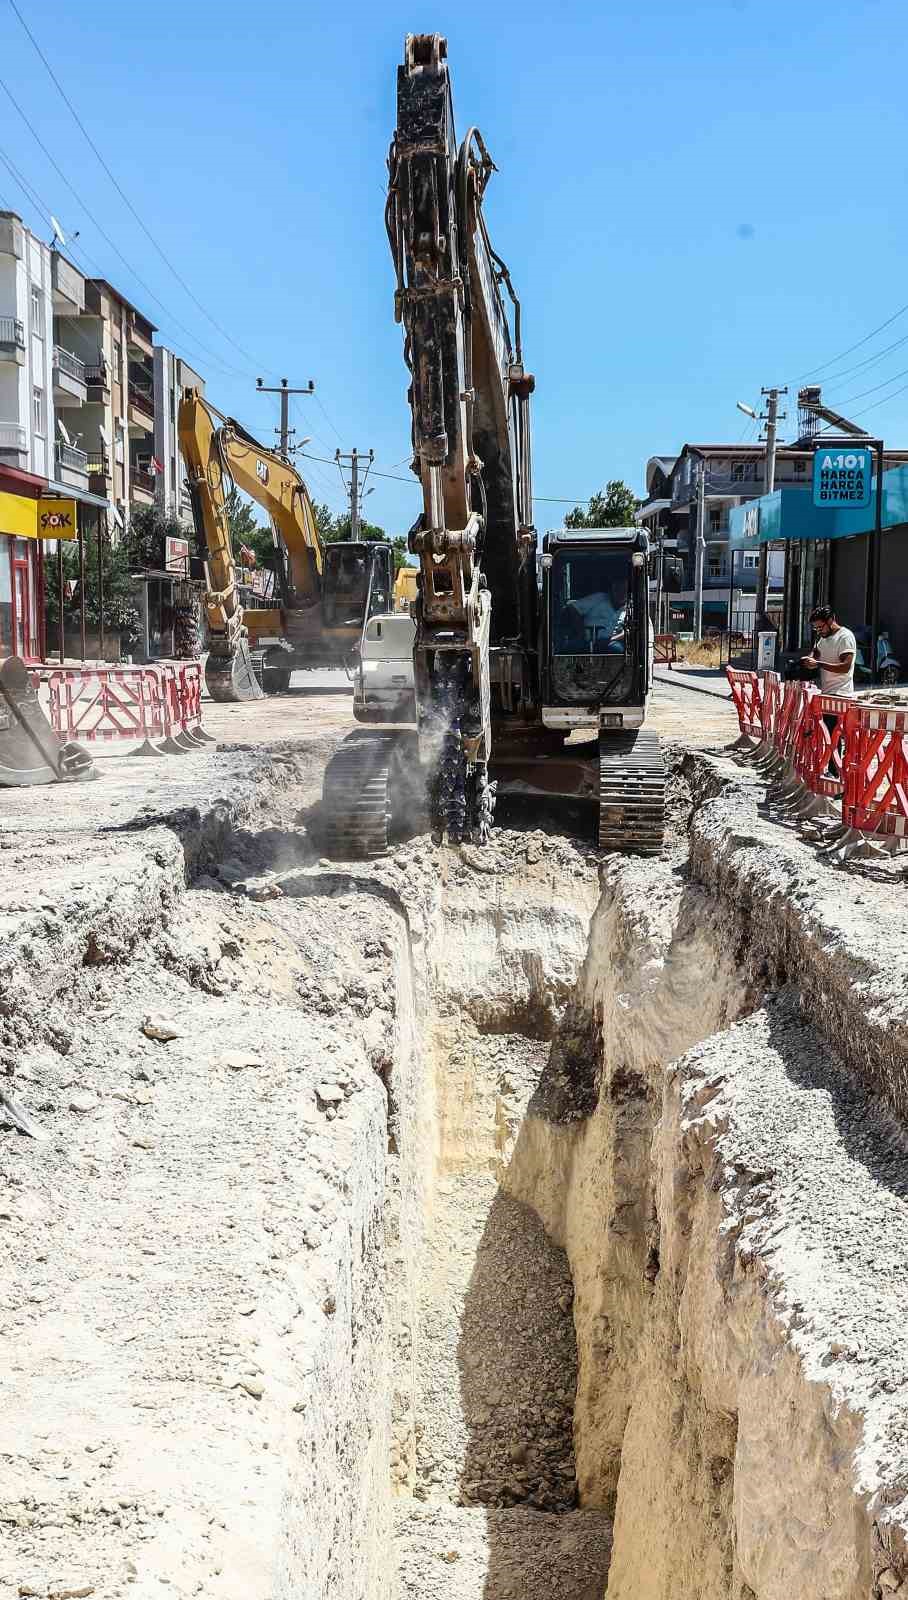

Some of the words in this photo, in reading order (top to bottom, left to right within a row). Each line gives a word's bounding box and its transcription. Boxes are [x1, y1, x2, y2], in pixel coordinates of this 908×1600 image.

[256, 459, 267, 481] CAT
[820, 470, 864, 479] HARCA
[820, 480, 864, 489] HARCA
